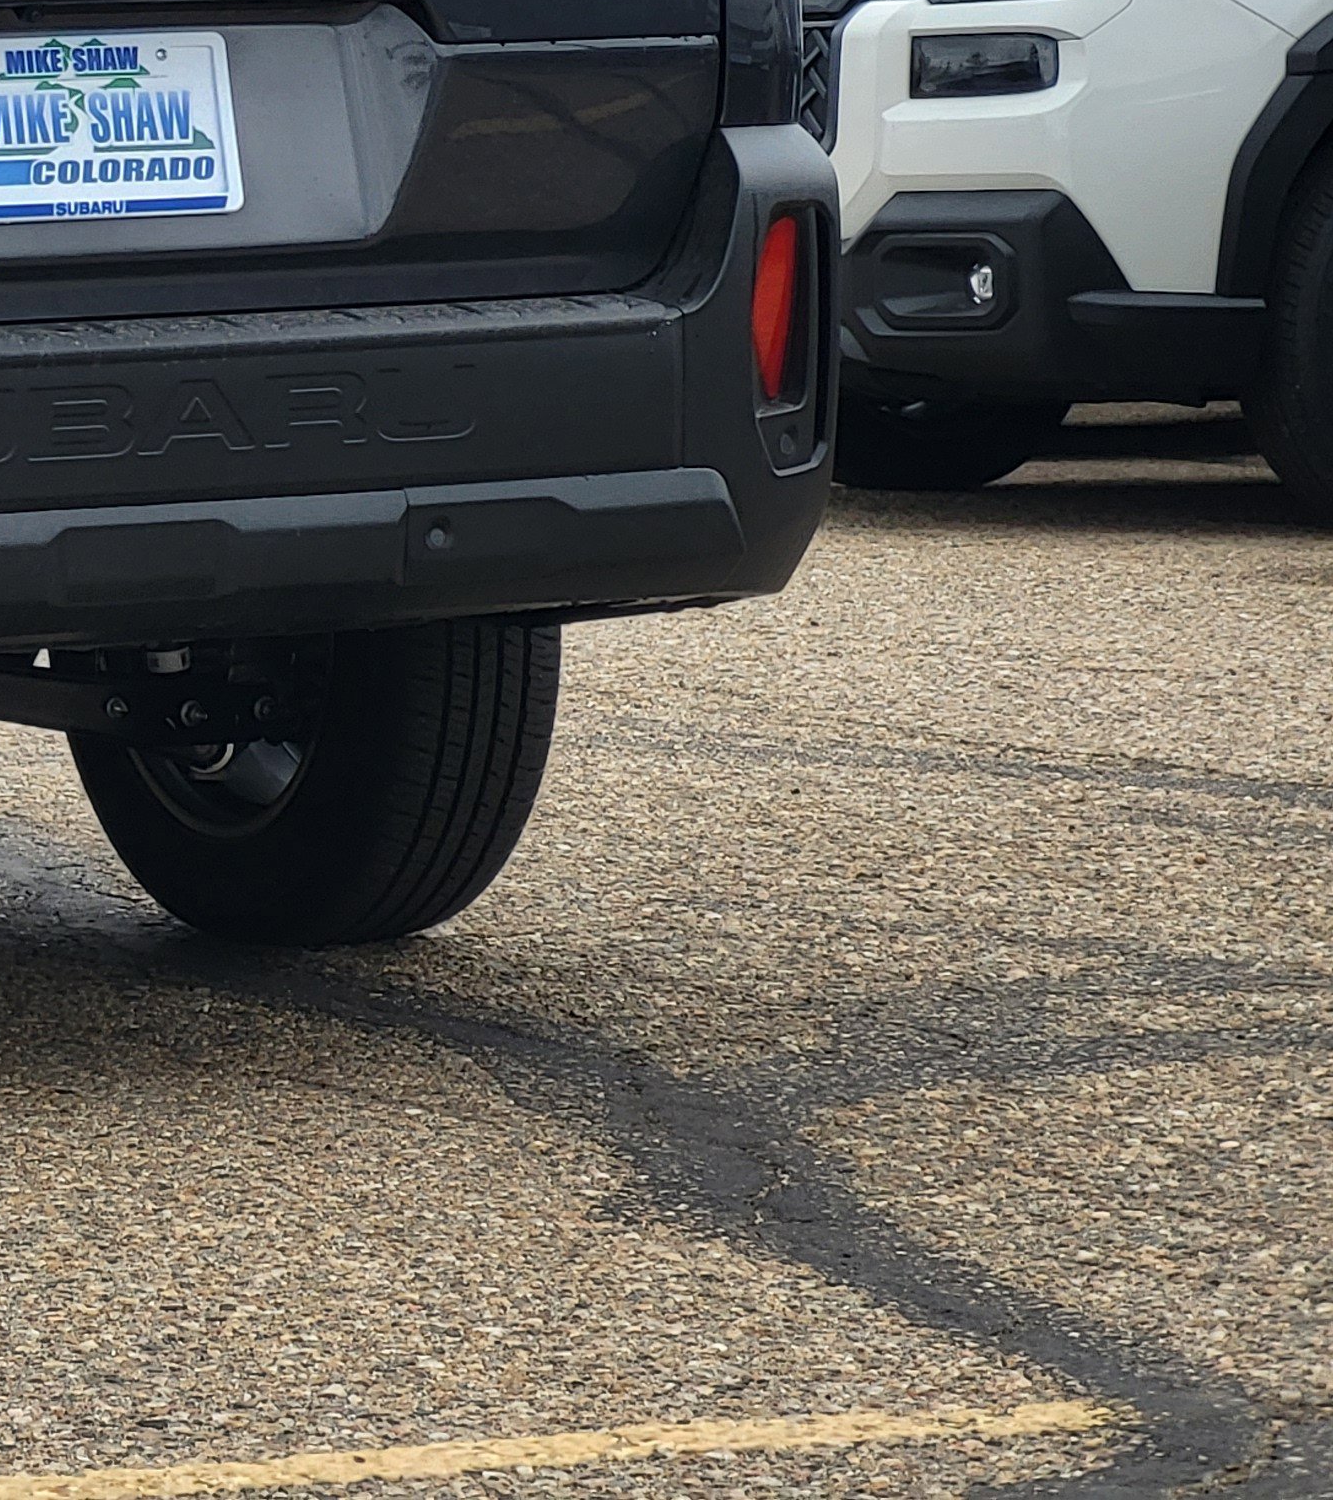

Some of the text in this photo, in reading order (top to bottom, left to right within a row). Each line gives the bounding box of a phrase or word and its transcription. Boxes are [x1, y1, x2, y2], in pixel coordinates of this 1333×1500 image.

[5, 46, 139, 74] MIKE SHAW
[89, 89, 191, 143] SHAW
[32, 156, 215, 186] COLORADO
[55, 200, 125, 216] SUBARU
